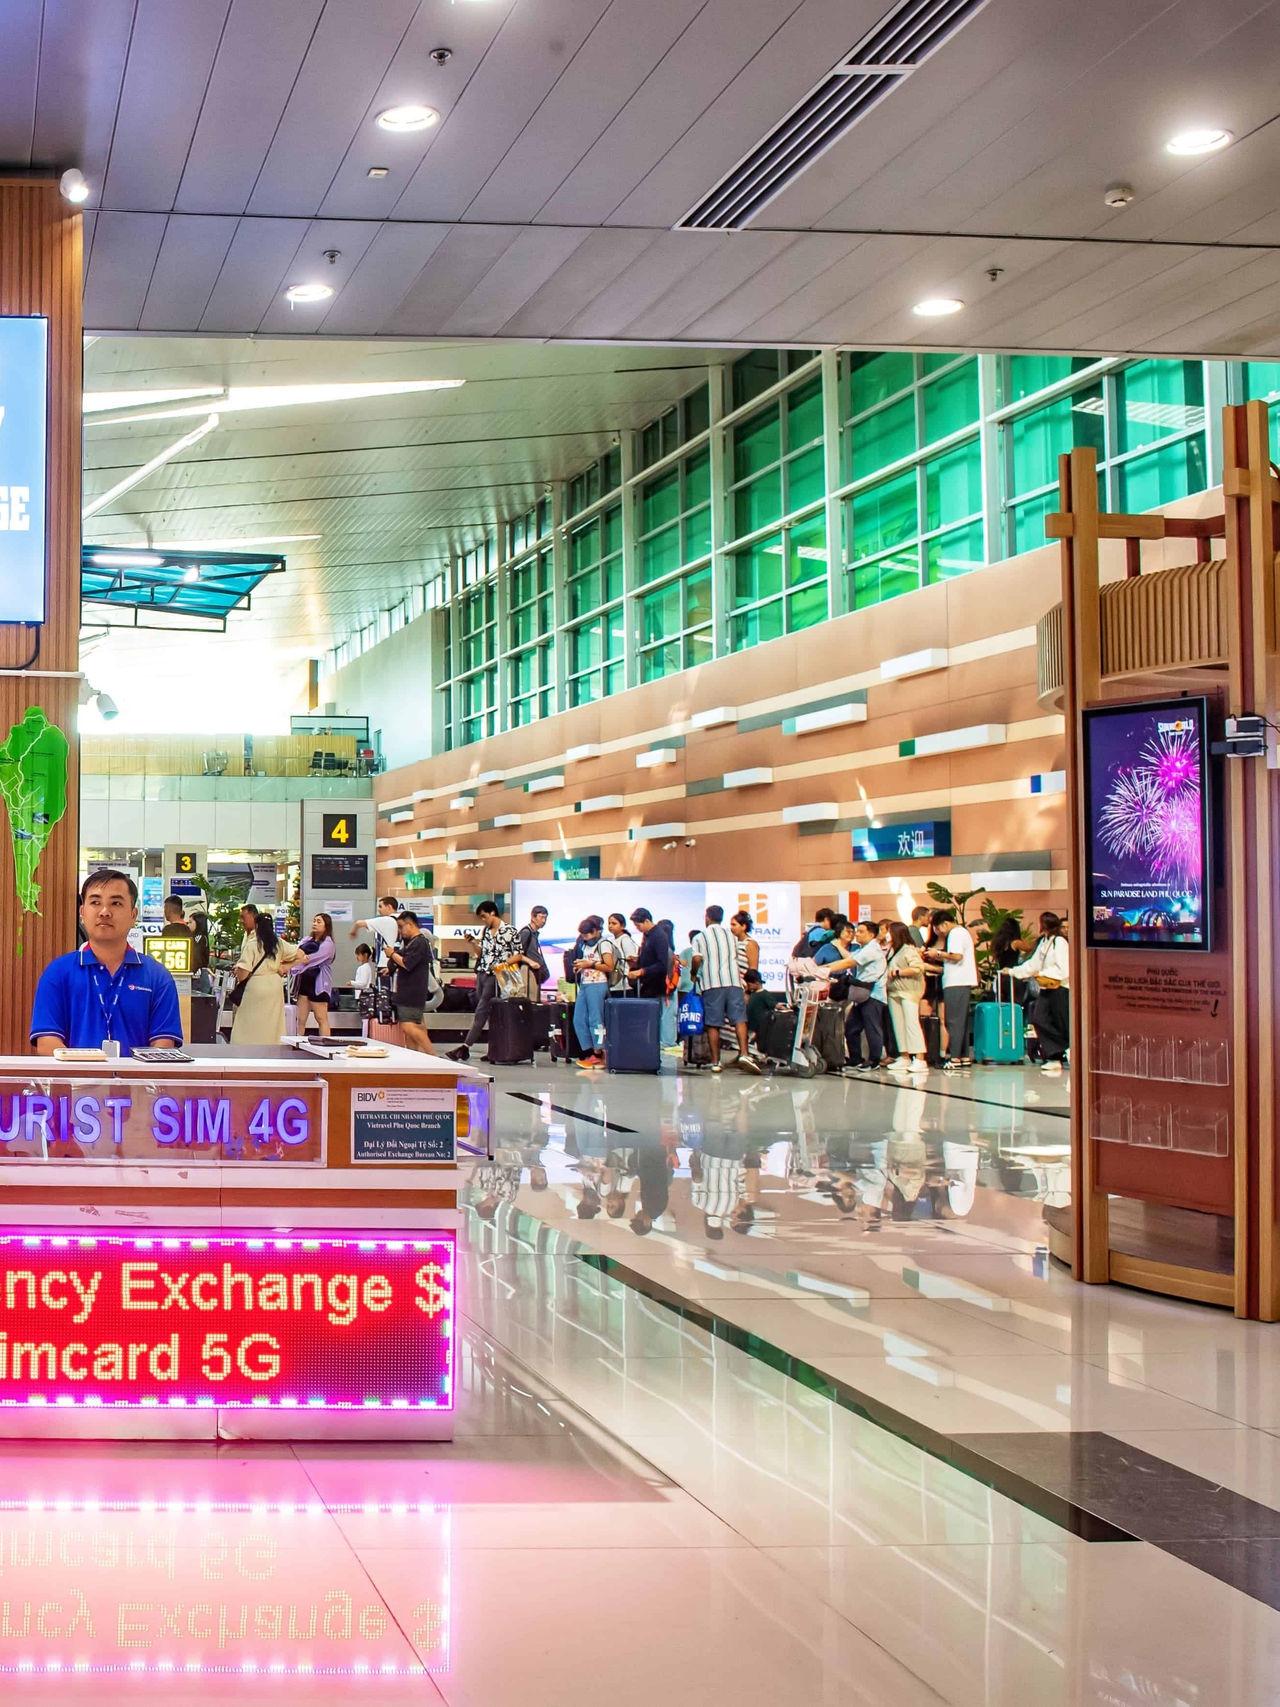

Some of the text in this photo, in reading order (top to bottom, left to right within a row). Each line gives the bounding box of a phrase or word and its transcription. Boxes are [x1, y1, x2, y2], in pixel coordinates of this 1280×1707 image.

[331, 819, 349, 843] 4
[898, 830, 925, 856] 欢迎
[181, 856, 192, 871] 3
[149, 941, 187, 950] SIM CARD
[165, 952, 186, 969] 5G
[358, 1093, 378, 1101] BIDV
[152, 1096, 231, 1145] SIM
[248, 1098, 310, 1145] 4G
[364, 1141, 375, 1149] Đại
[377, 1141, 385, 1149] Lý
[399, 1141, 417, 1149] Ngoại
[419, 1141, 427, 1149] Tệ
[122, 1263, 392, 1325] Exchange
[415, 1261, 445, 1319] $
[202, 1333, 280, 1381] 5G
